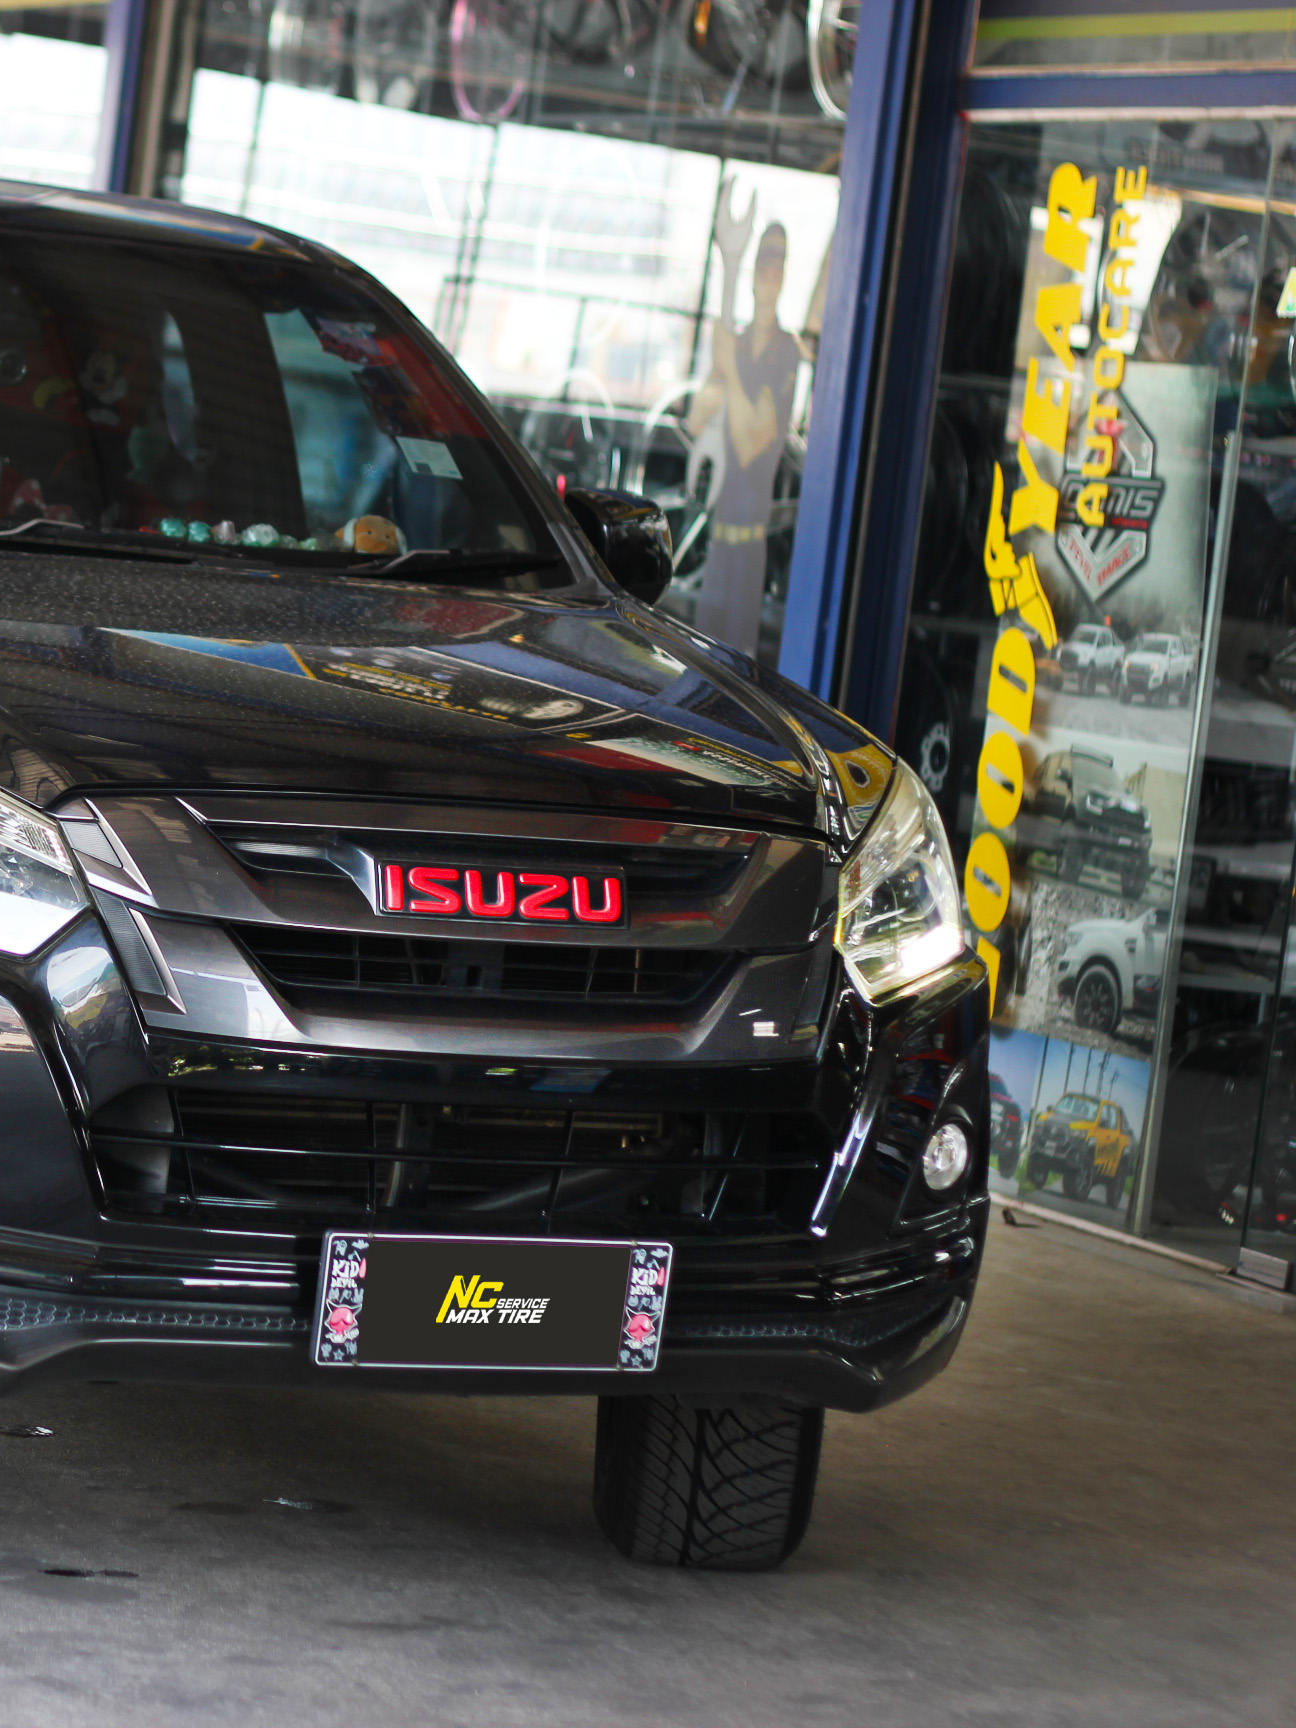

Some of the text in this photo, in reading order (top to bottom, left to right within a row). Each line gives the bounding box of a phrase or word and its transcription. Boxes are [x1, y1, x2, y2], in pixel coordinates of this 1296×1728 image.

[1076, 165, 1148, 528] AUTOCARE
[964, 162, 1098, 1018] OODYEAR
[385, 865, 621, 923] ISUZU
